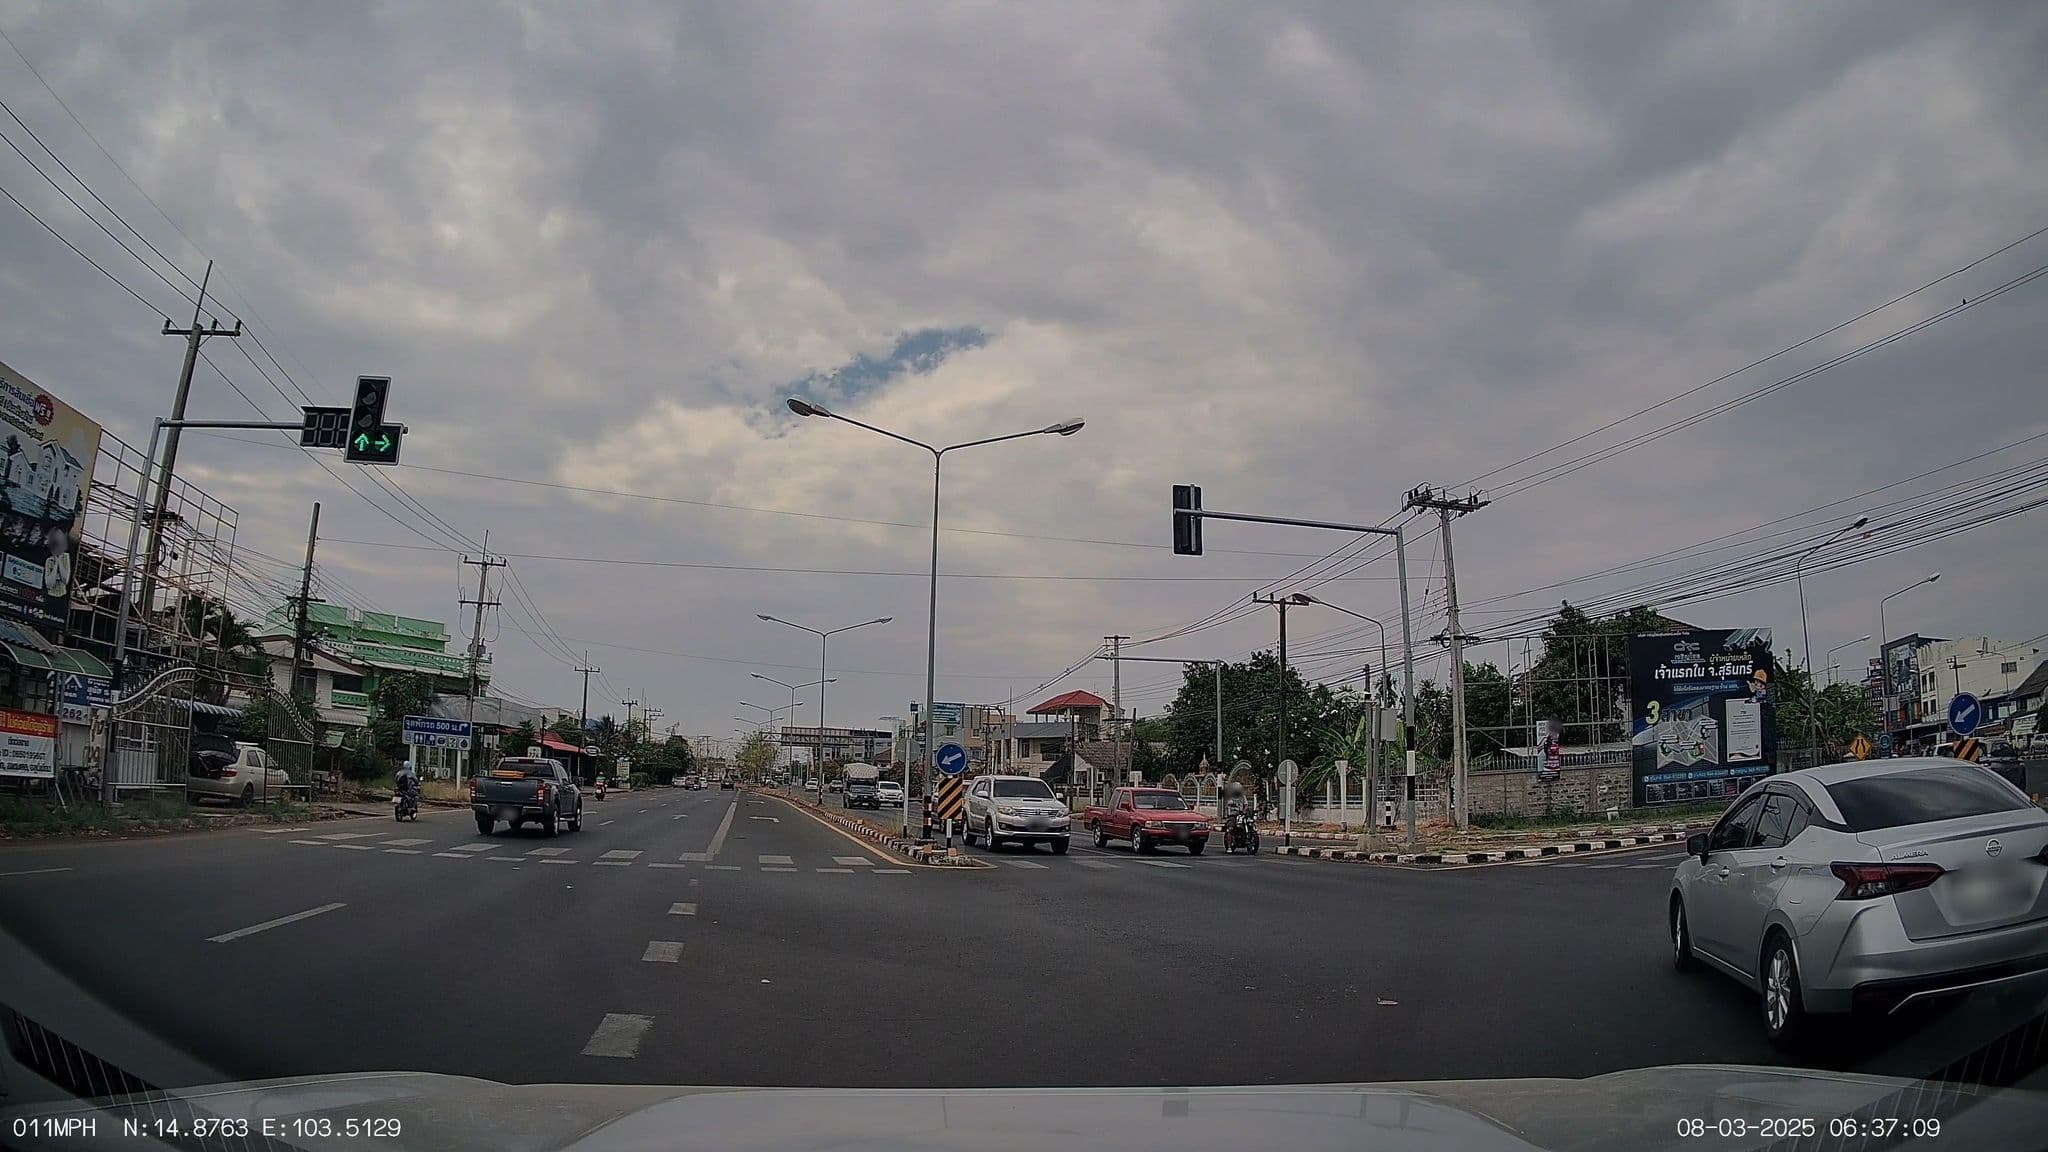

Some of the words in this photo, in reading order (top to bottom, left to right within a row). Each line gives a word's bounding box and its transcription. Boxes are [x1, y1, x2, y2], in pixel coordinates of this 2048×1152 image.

[1654, 663, 1705, 680] เจ้าแรกใน
[1707, 660, 1753, 681] จ.สุรินทร์
[63, 707, 82, 720] 262
[1645, 700, 1661, 725] 3
[436, 722, 450, 730] 500
[1890, 850, 1929, 862] ALMERA
